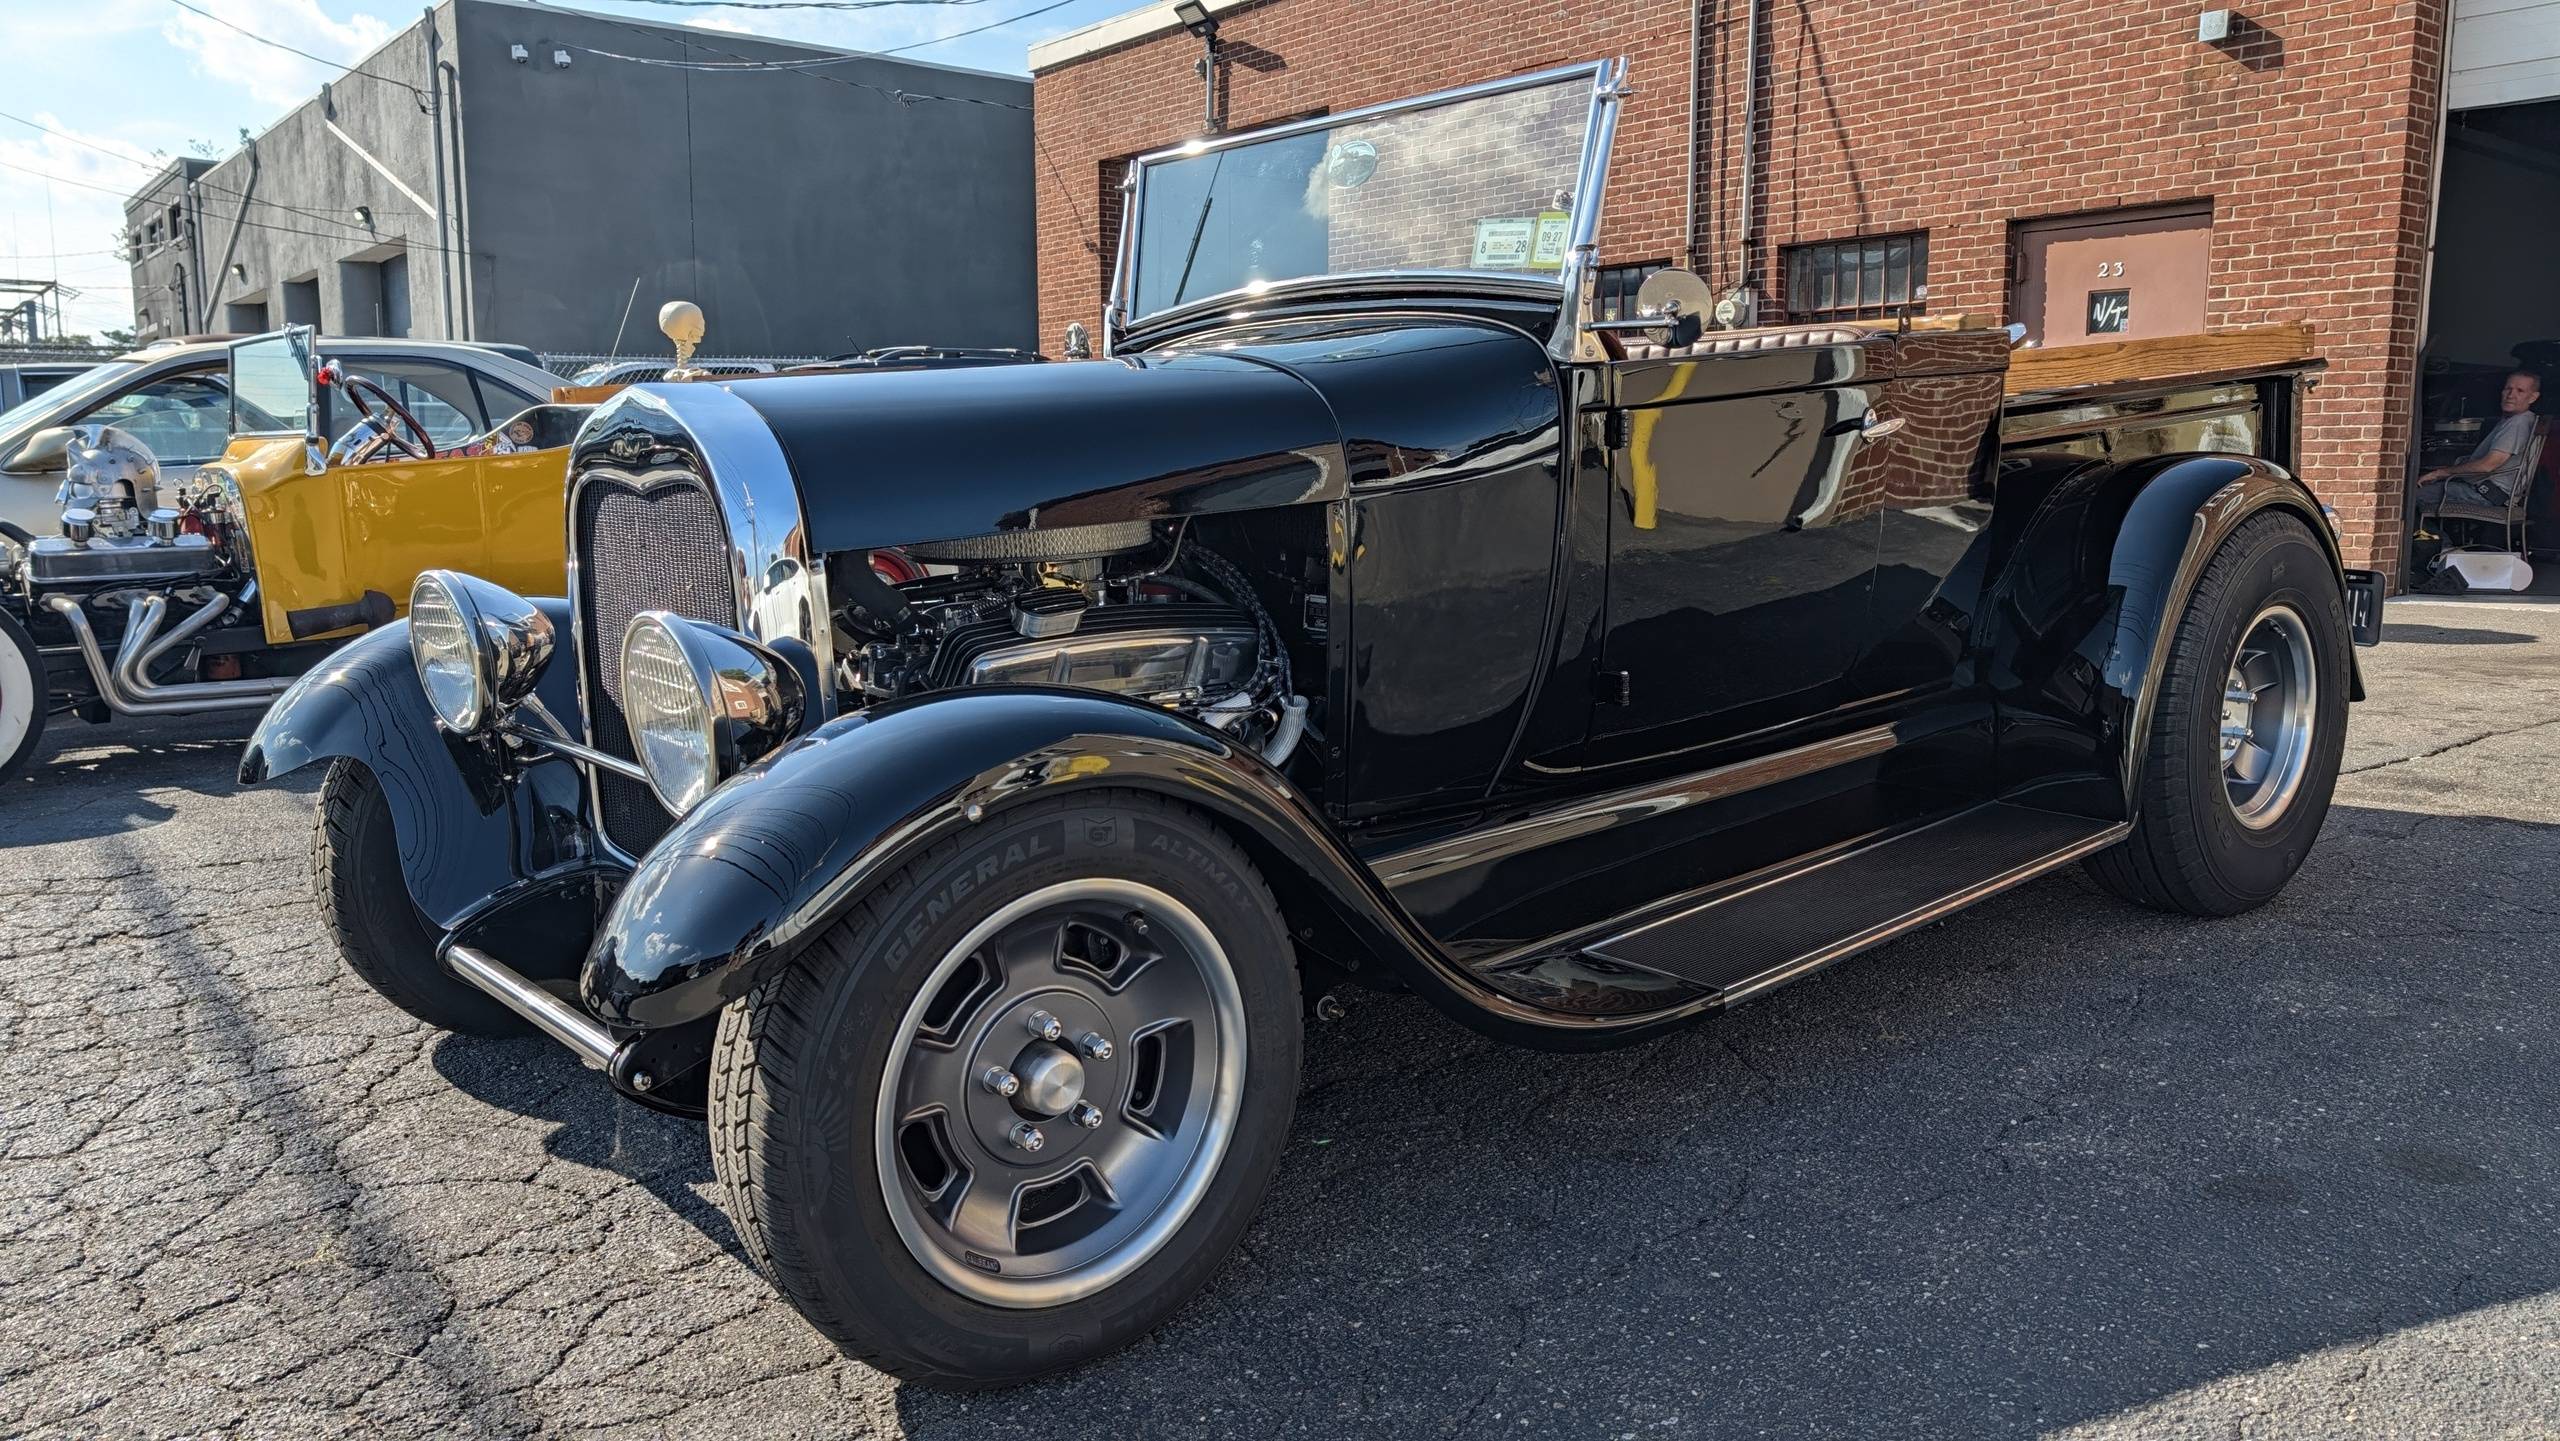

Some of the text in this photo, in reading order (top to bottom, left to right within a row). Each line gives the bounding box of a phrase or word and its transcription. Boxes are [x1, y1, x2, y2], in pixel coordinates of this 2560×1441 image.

[1541, 231, 1564, 242] 09 27
[1480, 241, 1487, 254] 8
[1515, 240, 1528, 254] 28
[2097, 261, 2125, 278] 23
[1150, 833, 1253, 912] ALTIMAX
[884, 834, 1052, 973] GENERAL
